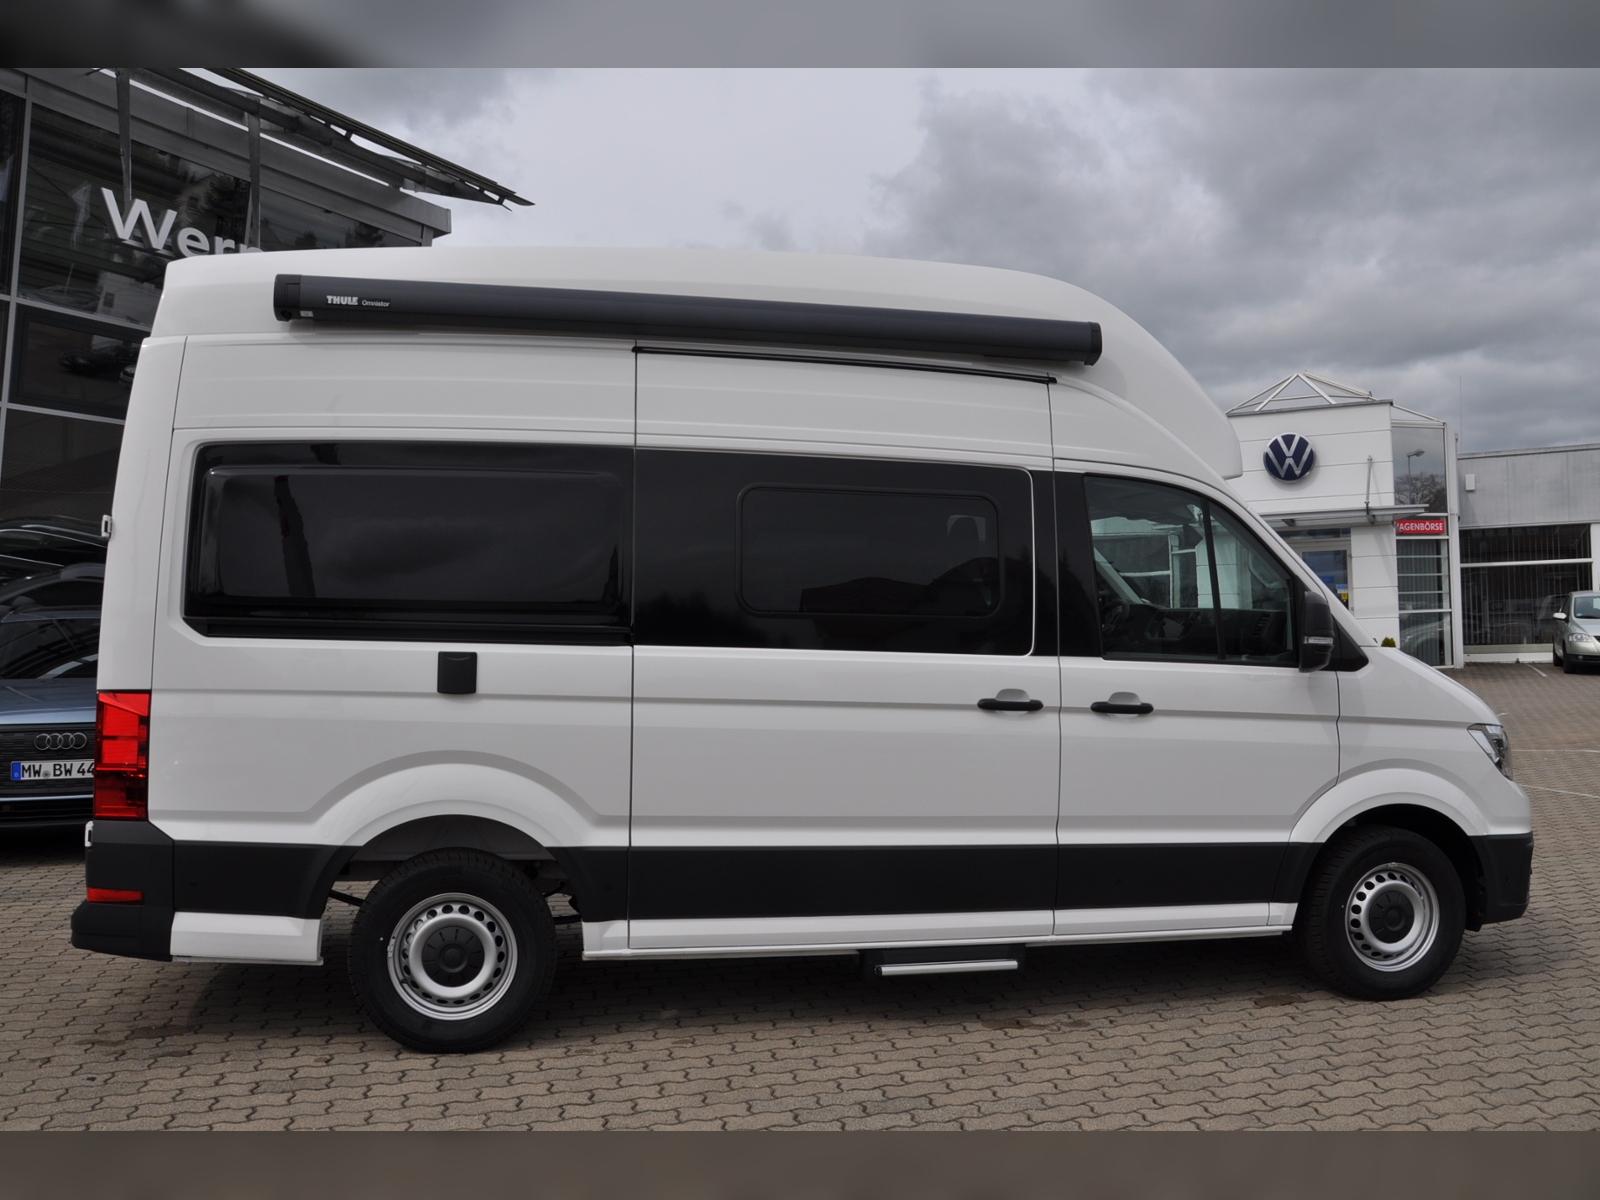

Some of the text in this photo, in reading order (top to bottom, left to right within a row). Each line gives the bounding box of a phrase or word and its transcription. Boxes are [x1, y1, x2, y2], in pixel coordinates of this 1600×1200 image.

[326, 295, 390, 307] THULE Omnistor
[1396, 521, 1444, 531] AGENBÖRSE
[21, 764, 42, 778] MW
[53, 763, 73, 777] BW
